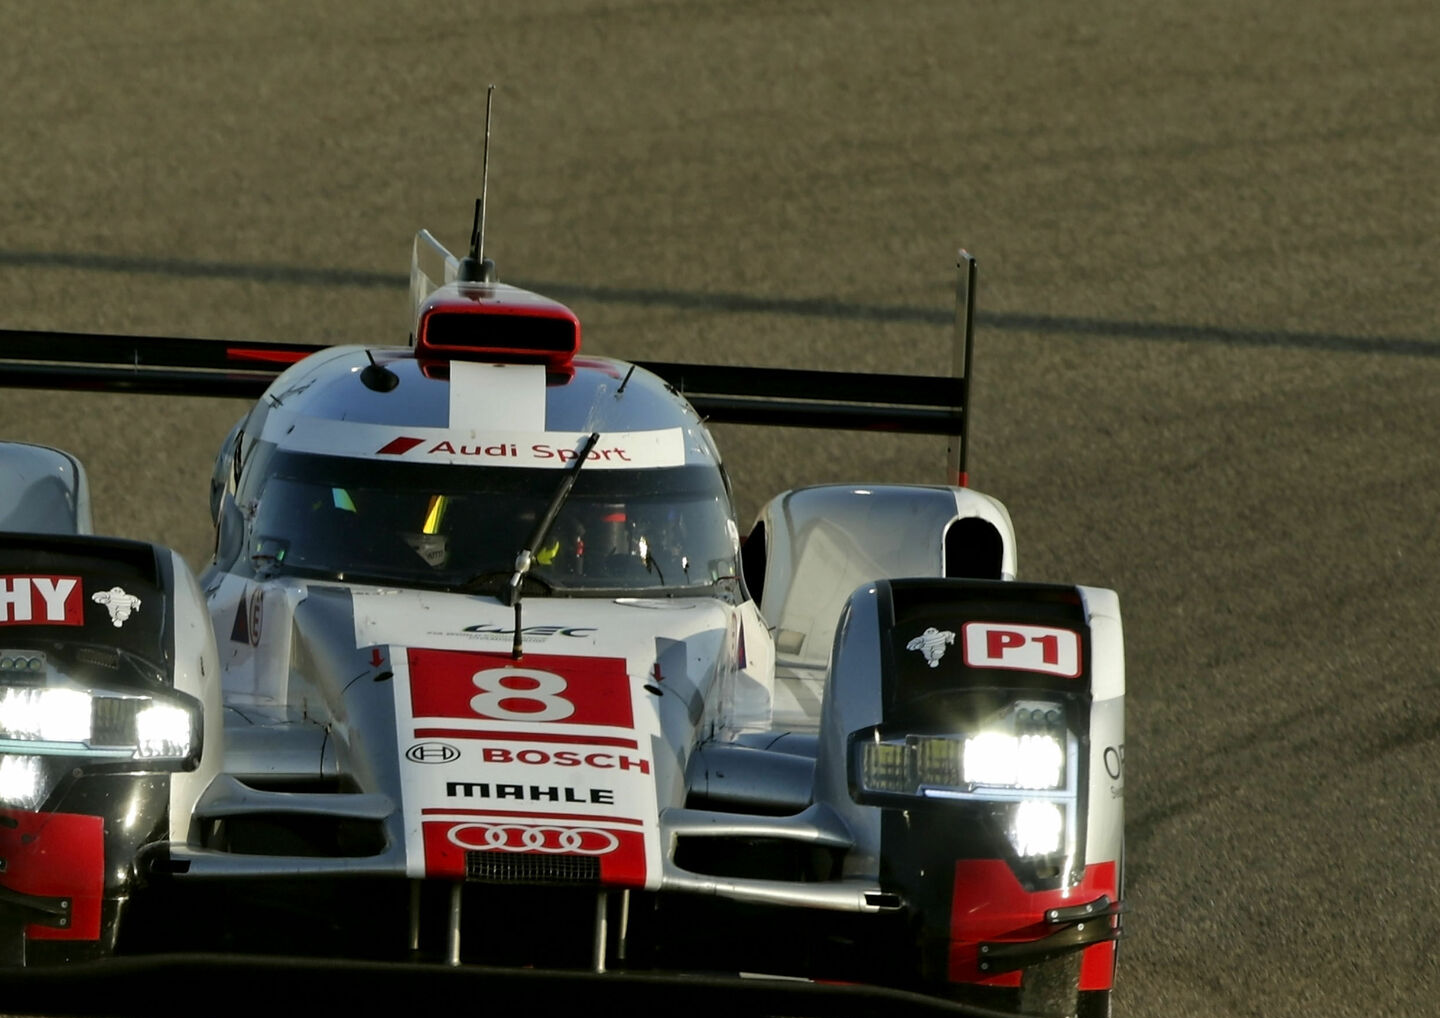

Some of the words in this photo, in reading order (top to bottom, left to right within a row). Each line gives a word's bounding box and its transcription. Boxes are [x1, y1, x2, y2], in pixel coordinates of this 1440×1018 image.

[428, 440, 517, 457] Audi
[532, 444, 631, 462] Sport
[462, 624, 598, 638] WEC
[987, 630, 1059, 665] P1
[470, 668, 576, 721] 8
[482, 748, 650, 774] BOSCH
[446, 782, 614, 805] MAHLE
